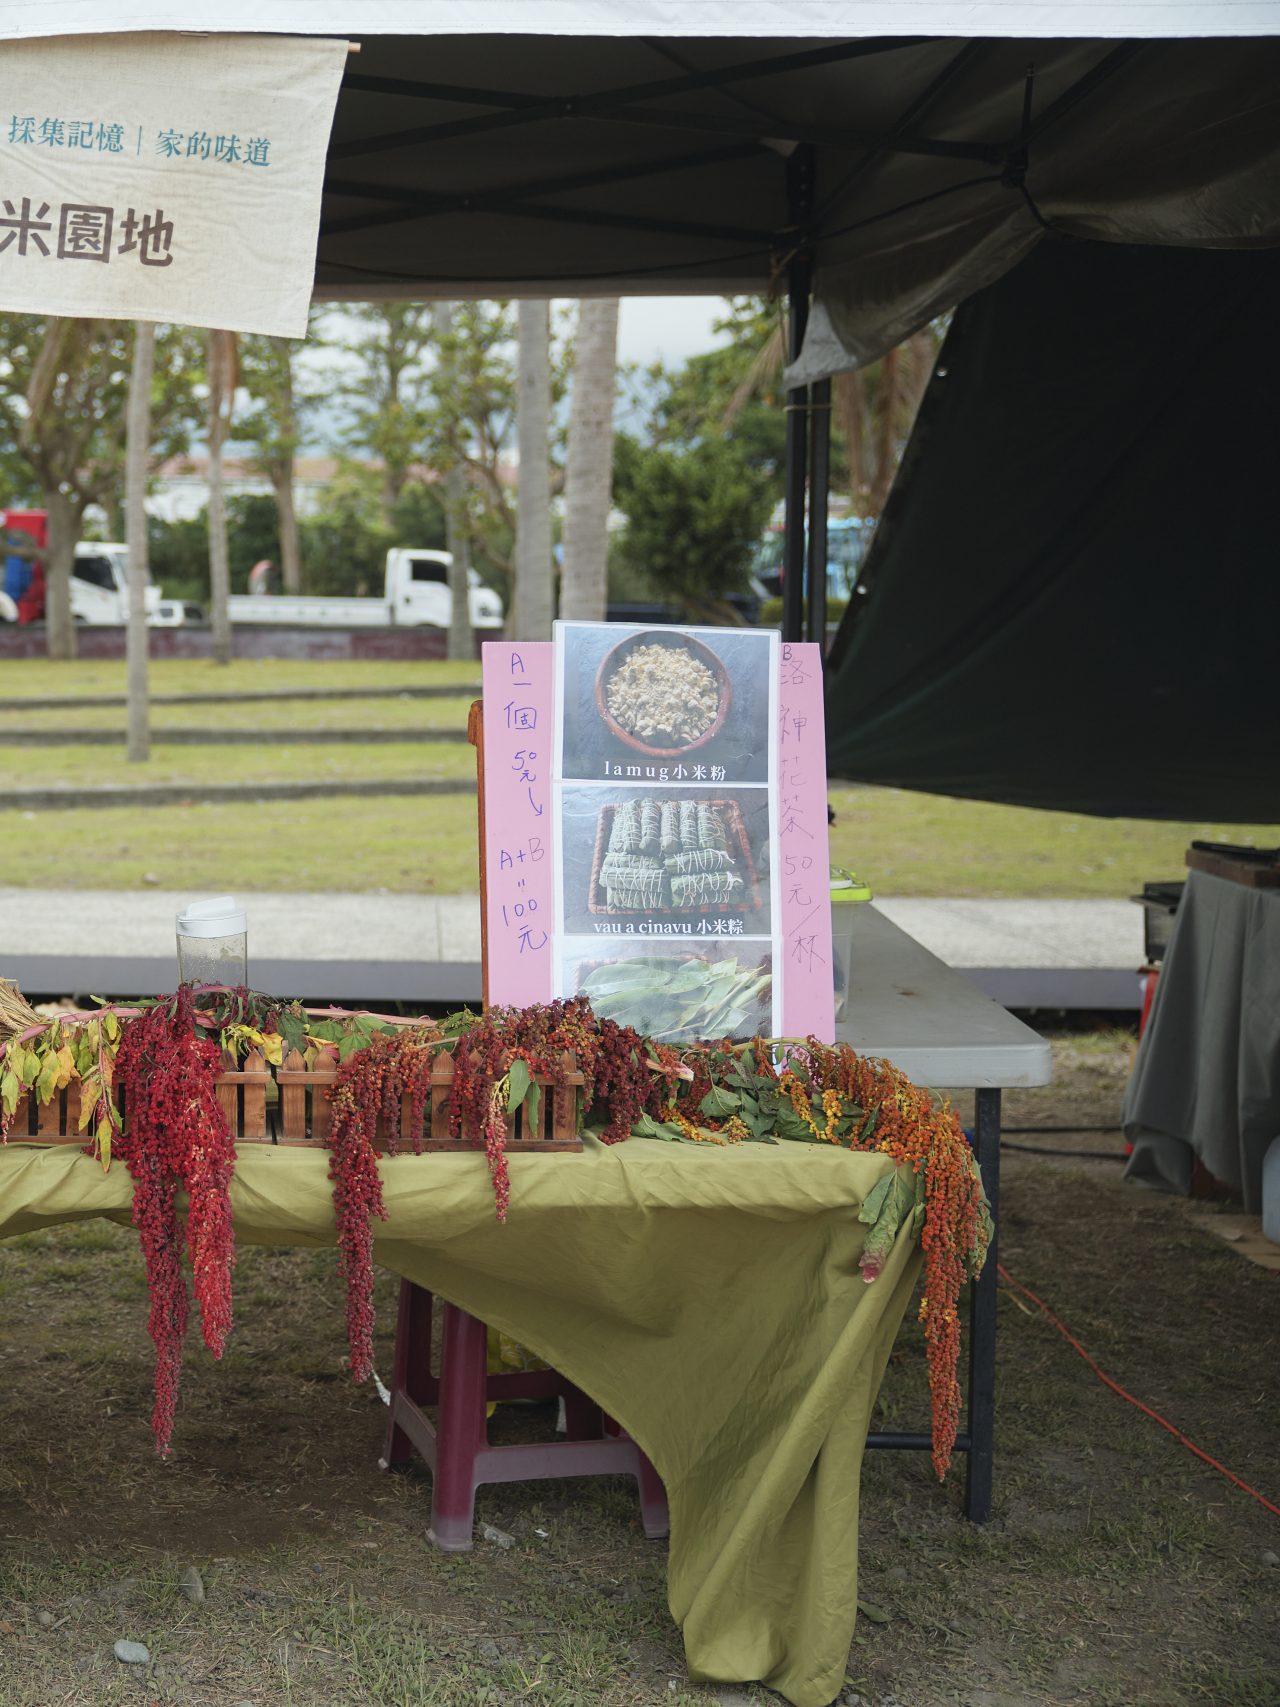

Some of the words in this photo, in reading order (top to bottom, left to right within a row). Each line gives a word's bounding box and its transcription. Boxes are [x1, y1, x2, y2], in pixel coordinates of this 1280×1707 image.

[8, 114, 125, 153] 採集記憶
[154, 128, 272, 167] 家的味道
[593, 922, 622, 934] vau
[625, 922, 635, 934] a
[638, 919, 692, 934] cinavu
[696, 918, 744, 935] 小米粽
